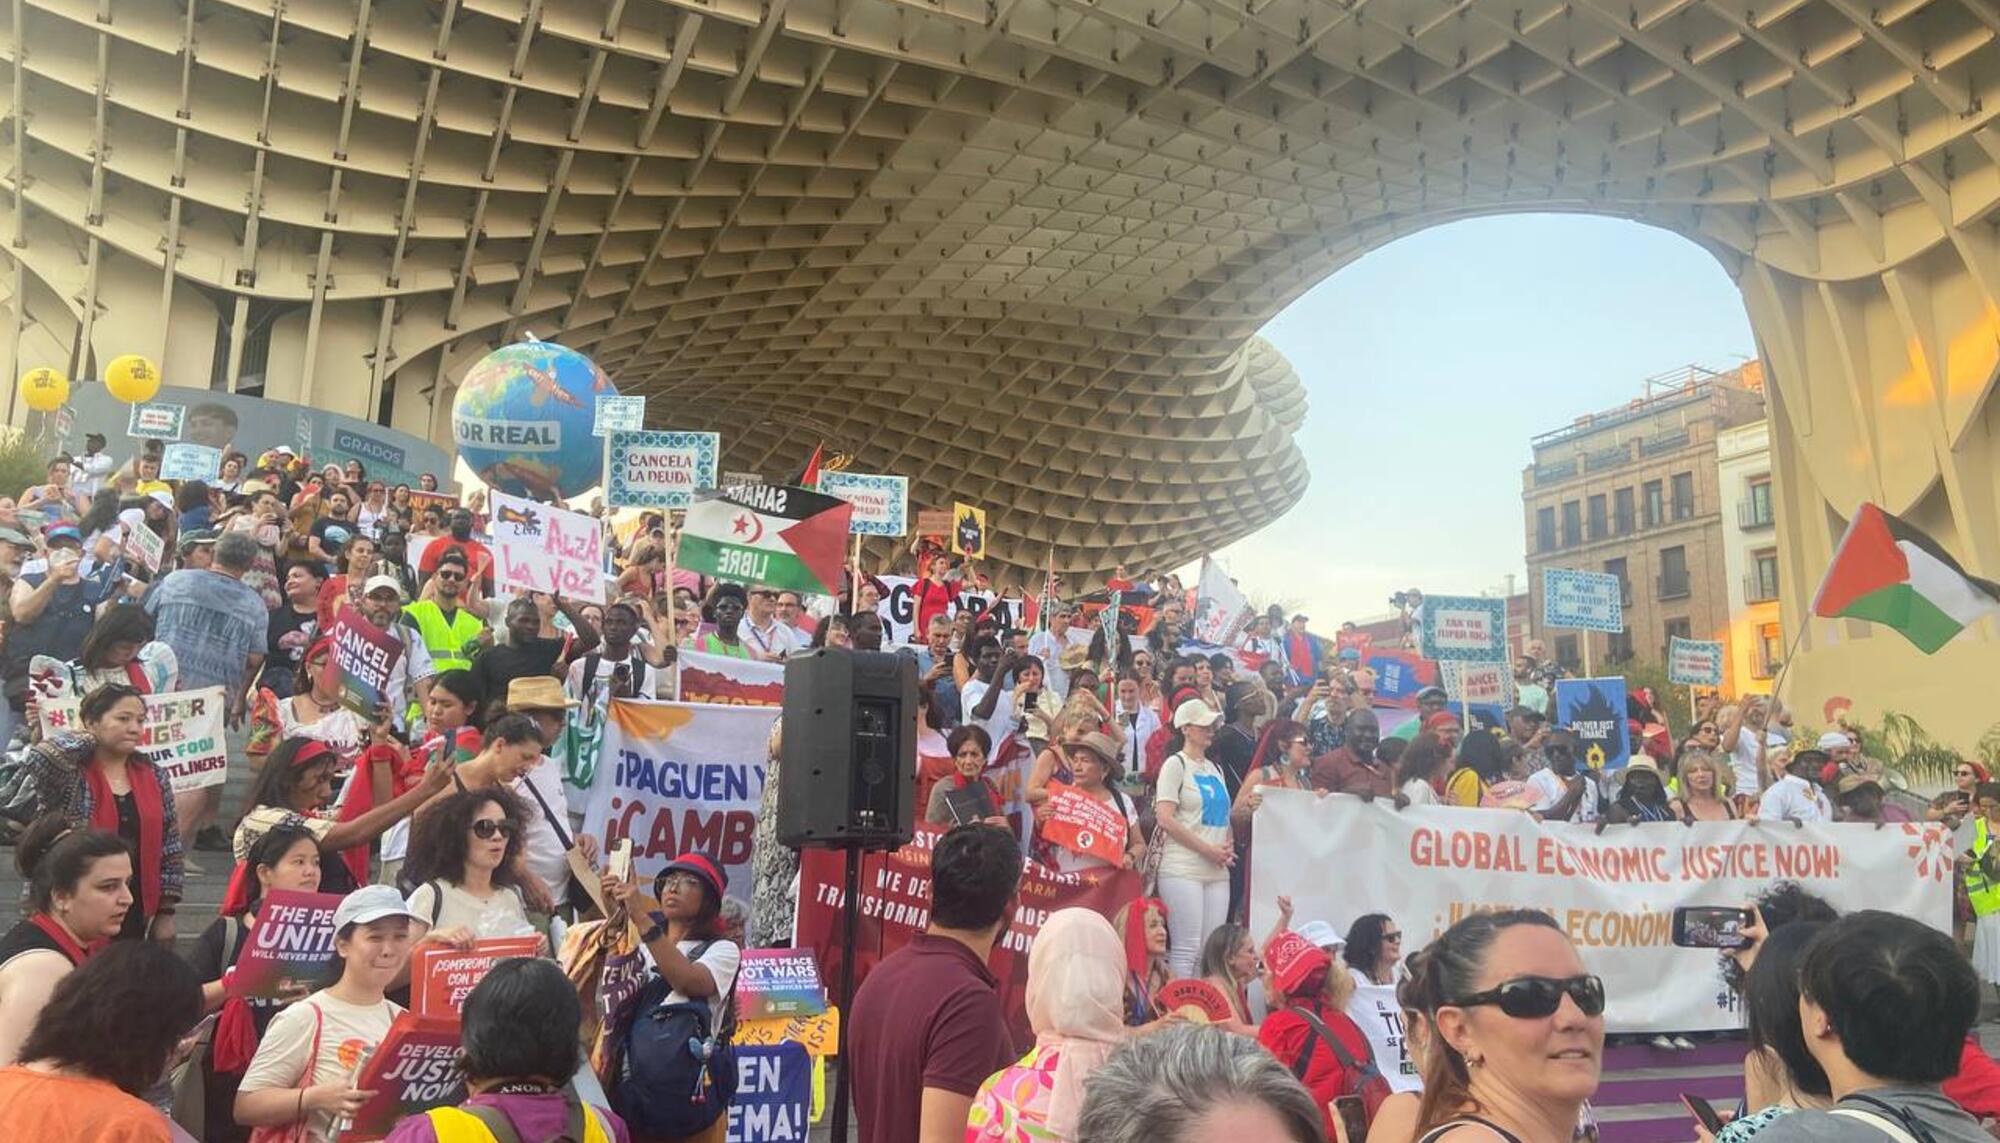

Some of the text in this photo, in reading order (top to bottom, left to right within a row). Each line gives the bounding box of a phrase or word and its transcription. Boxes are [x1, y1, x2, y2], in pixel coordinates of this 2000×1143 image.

[490, 425, 556, 446] REAL
[340, 435, 401, 464] GRADOS
[628, 453, 692, 468] CANCELA
[627, 470, 692, 484] LA DEUDA
[545, 517, 599, 563] ALZA
[549, 560, 597, 597] VOZ
[335, 620, 389, 675] CANCEL
[331, 640, 387, 691] THE DEBT
[176, 737, 214, 757] FOOD
[615, 748, 748, 801] ¡PAGUEN
[1410, 827, 1840, 883] GLOBAL ECONOMIC JUSTICE NOW!
[907, 876, 932, 900] DE
[269, 905, 334, 925] THE PE
[251, 948, 274, 959] WILL
[276, 951, 307, 961] NEVER
[779, 956, 814, 966] PEACE
[447, 972, 470, 986] CON
[768, 964, 817, 978] WARS
